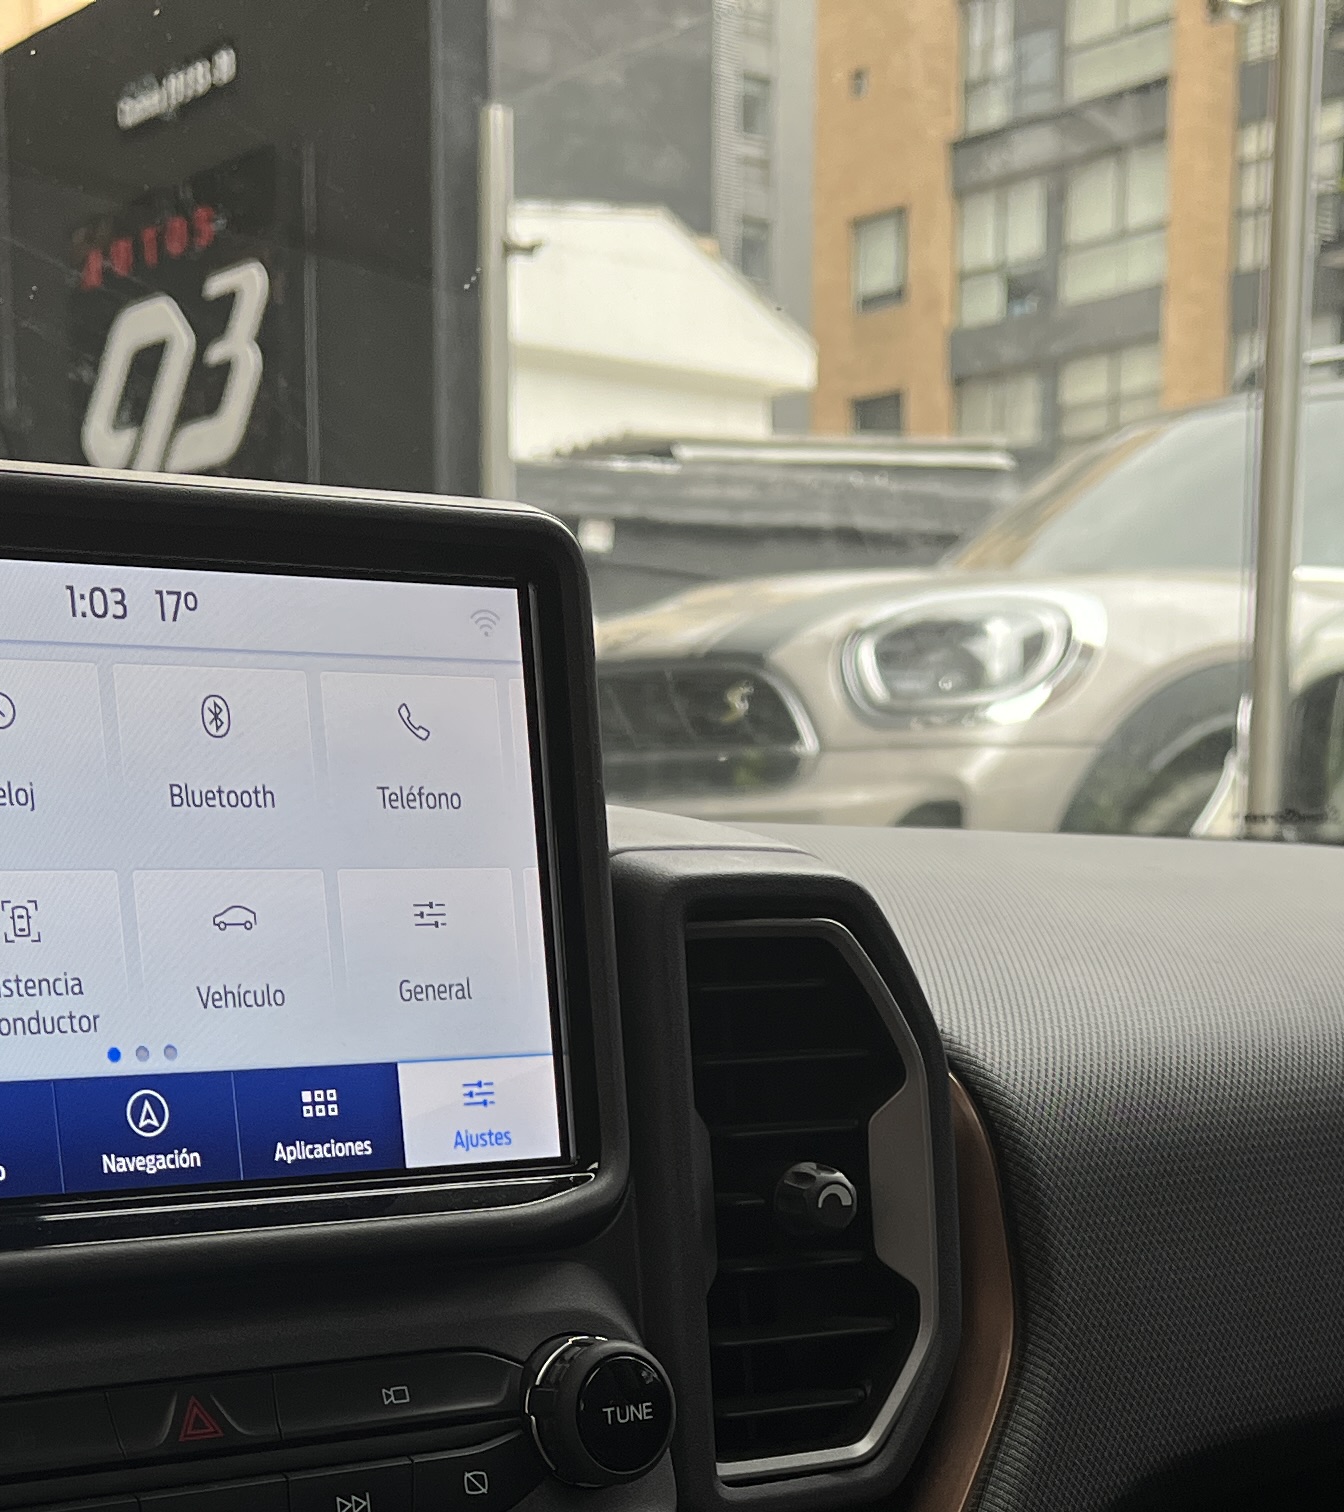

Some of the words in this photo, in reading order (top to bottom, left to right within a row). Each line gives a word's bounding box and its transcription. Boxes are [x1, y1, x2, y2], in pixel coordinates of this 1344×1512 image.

[64, 584, 129, 620] 1:03
[168, 783, 276, 809] Bluetooth
[376, 785, 463, 810] Teléfono
[196, 983, 286, 1010] Vehículo
[398, 976, 473, 1003] General
[273, 1137, 373, 1163] Aplicaciones
[453, 1128, 513, 1152] Ajustes
[101, 1146, 202, 1174] Navegación
[601, 1402, 654, 1425] TUNE
